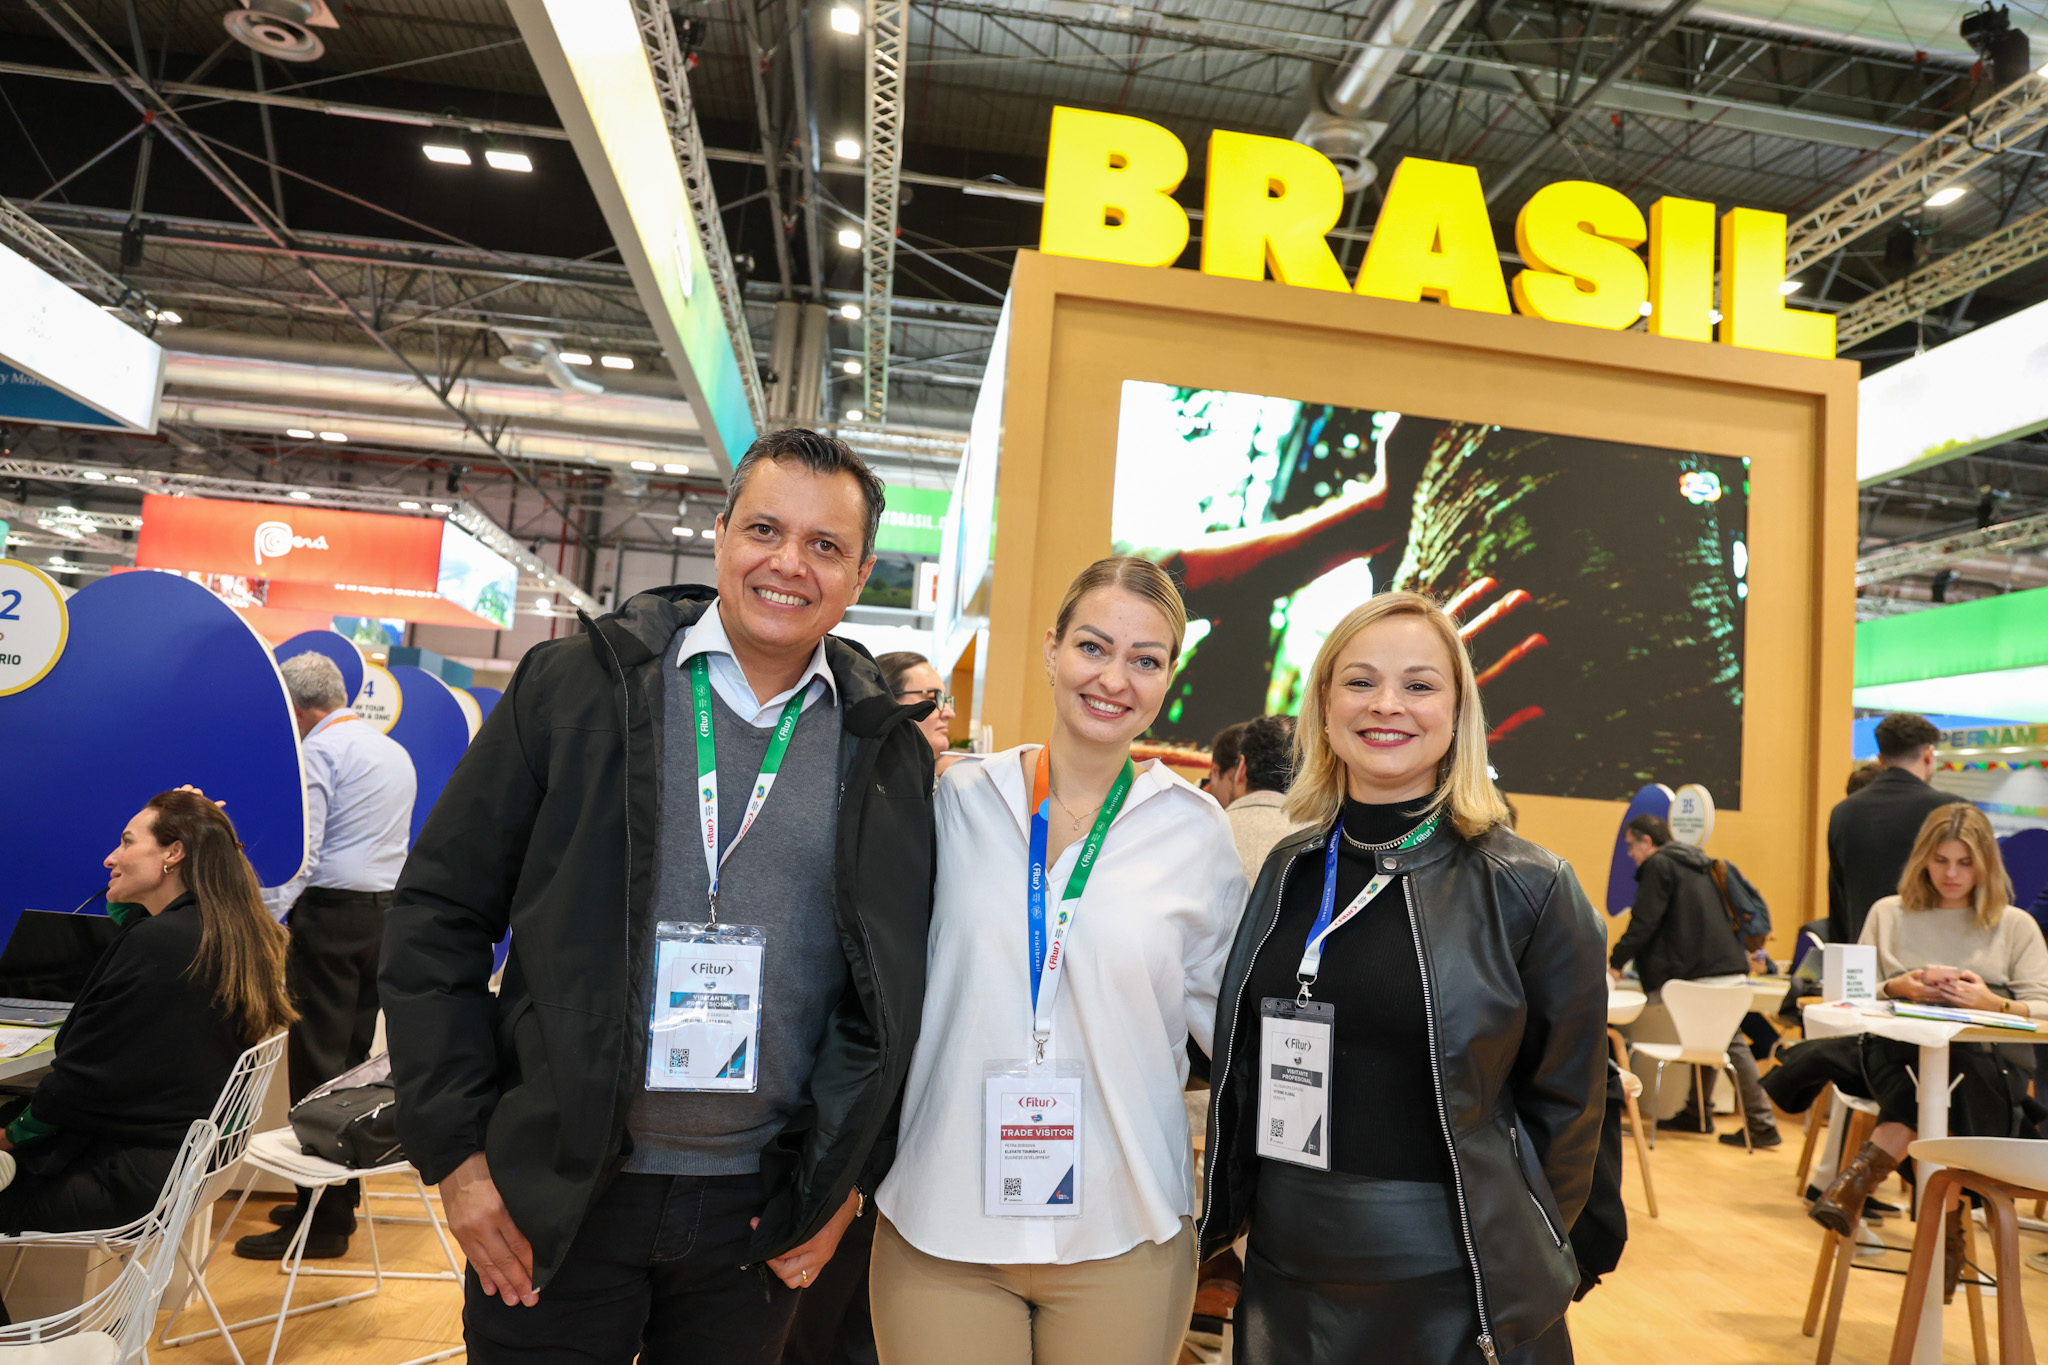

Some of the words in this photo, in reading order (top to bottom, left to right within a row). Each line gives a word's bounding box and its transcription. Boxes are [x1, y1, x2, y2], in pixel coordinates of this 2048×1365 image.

[1040, 105, 1836, 359] BRASIL
[1002, 1128, 1034, 1137] TRADE
[1035, 1128, 1073, 1137] VISITOR
